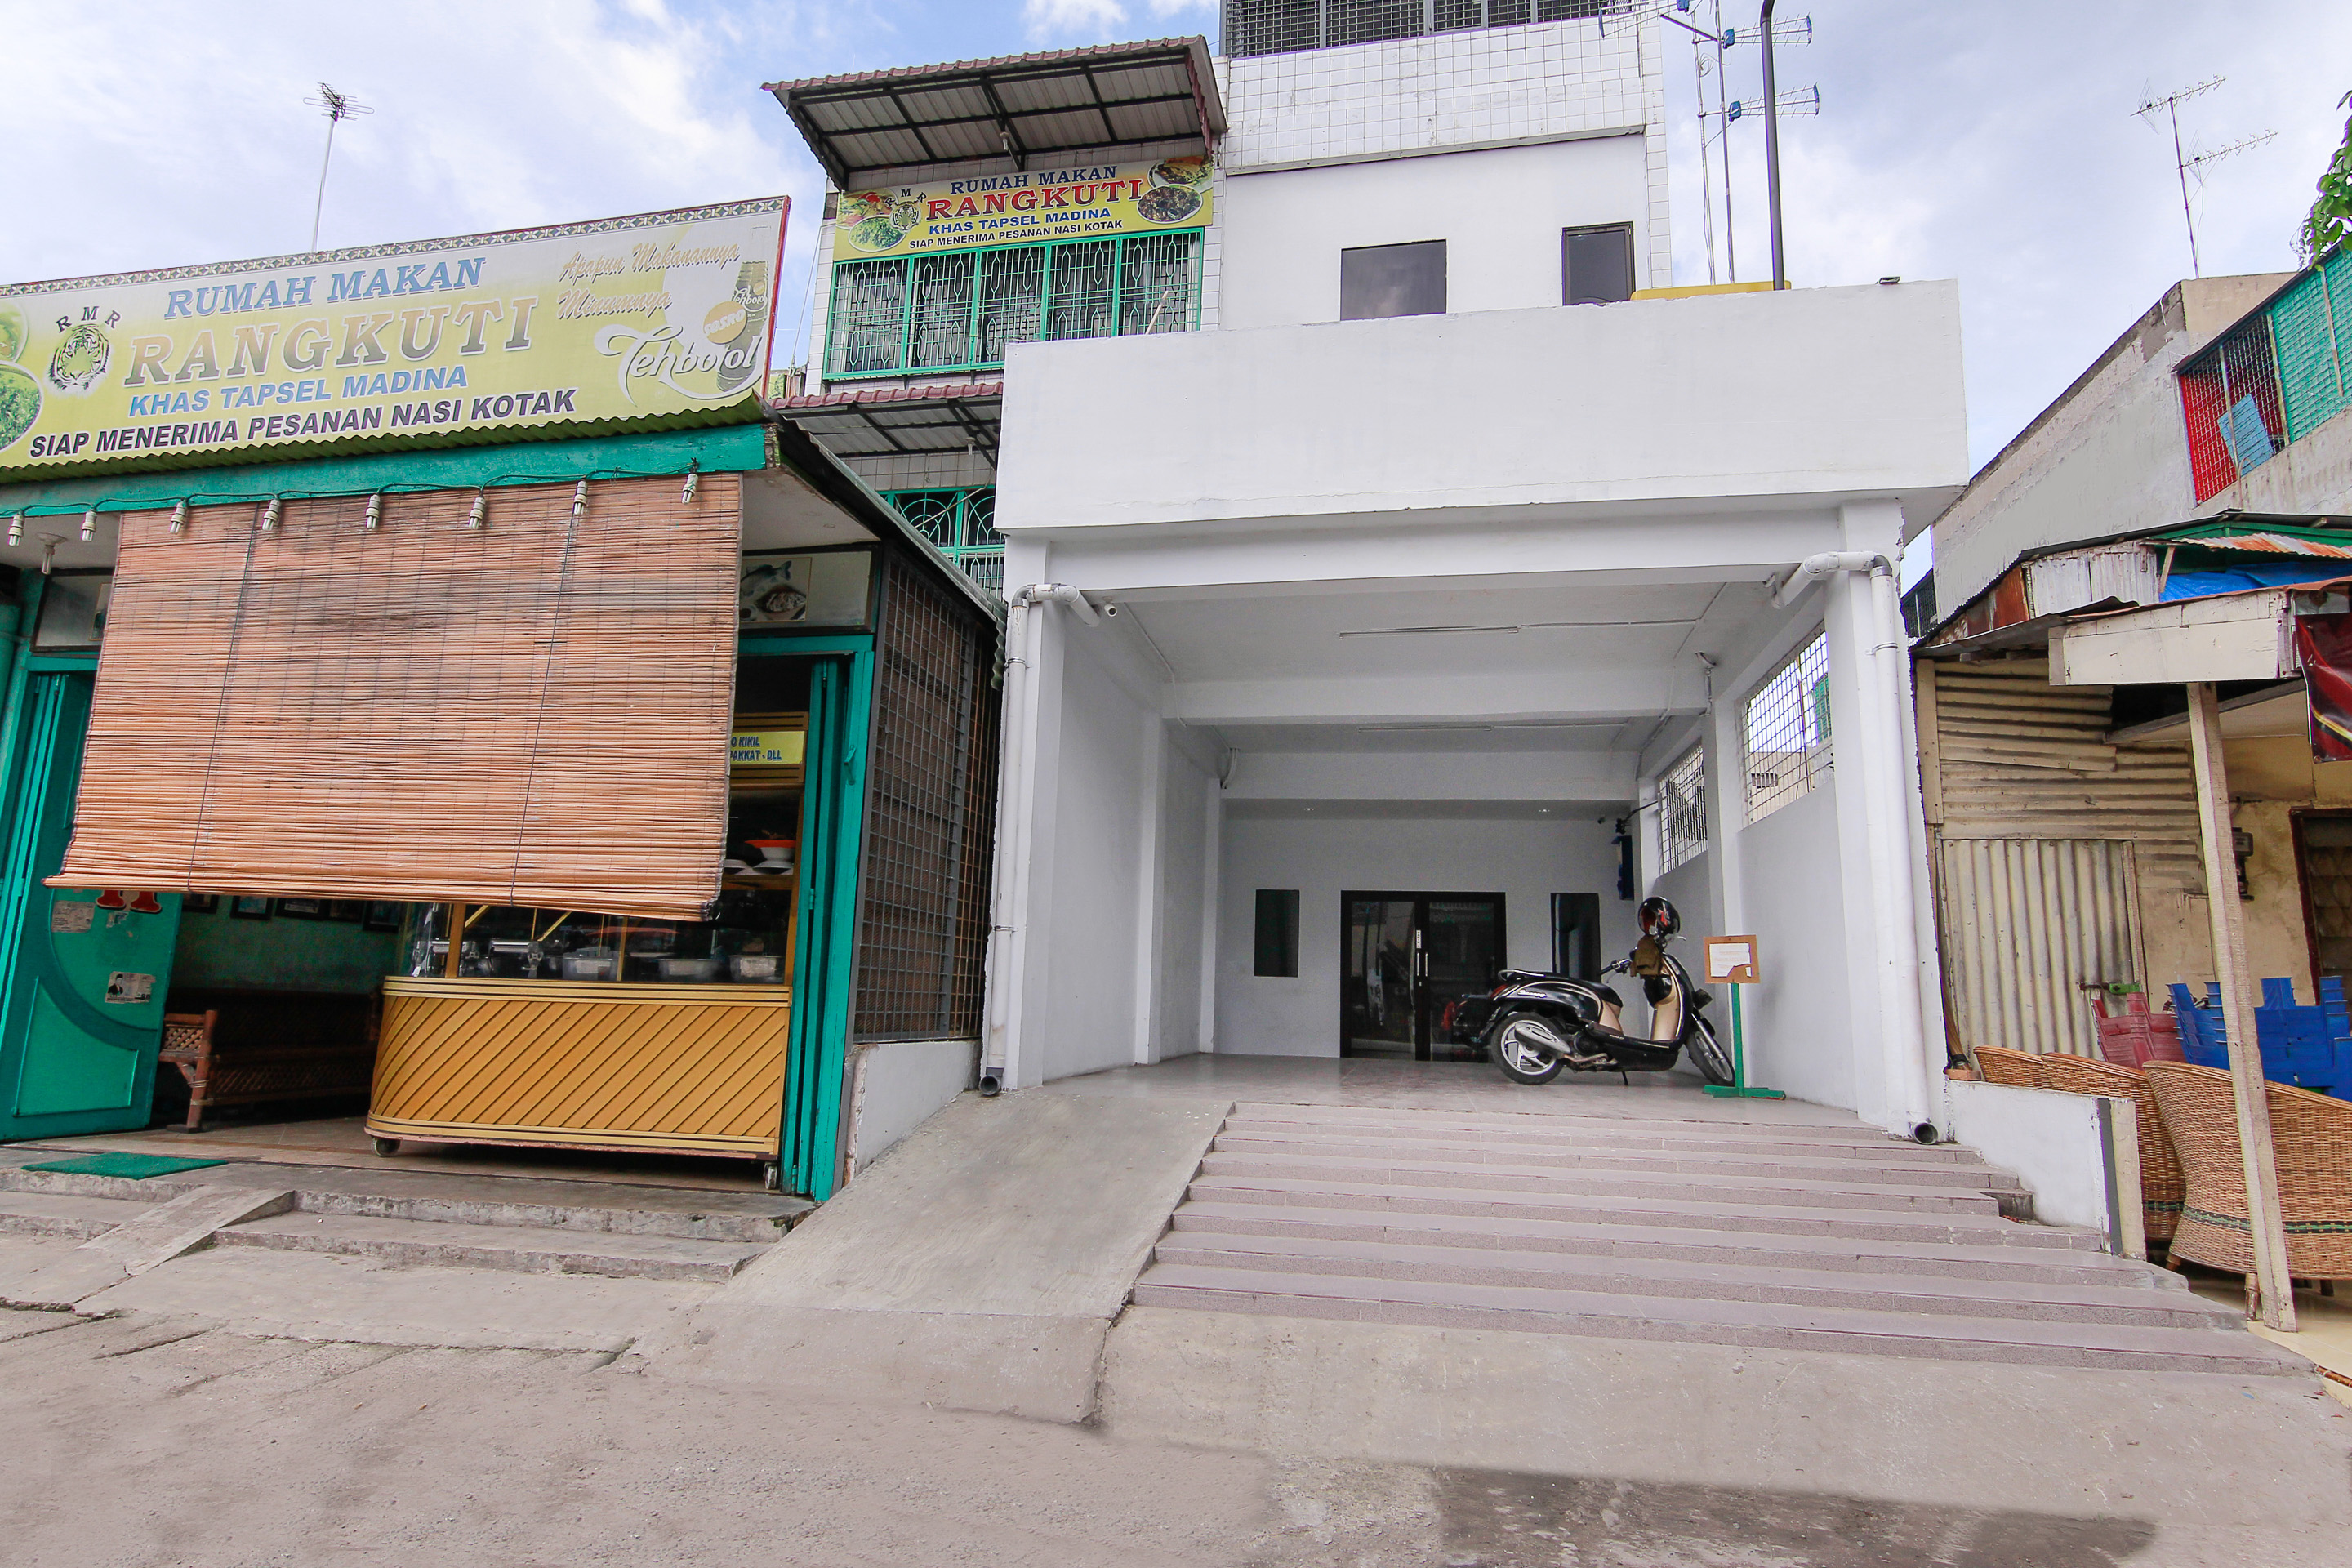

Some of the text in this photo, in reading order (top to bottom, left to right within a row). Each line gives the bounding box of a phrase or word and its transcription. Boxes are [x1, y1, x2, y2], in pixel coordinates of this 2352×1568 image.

[950, 166, 1117, 195] RUMAH MAKAN
[884, 188, 927, 207] R M R
[926, 179, 1143, 221] RANGKUTI
[909, 220, 1123, 249] SIAP MENERIMA PESANAN NASI KOTAK
[929, 207, 1111, 235] KHAS TAPSEL MADINA
[559, 242, 741, 286] Apapun Makanannya
[164, 257, 486, 319] RUMAH MAKAN
[557, 288, 673, 320] Minumnya
[55, 305, 122, 334] R M R
[123, 296, 538, 385] RANGKUTI
[594, 323, 764, 408] Tehbotol
[129, 366, 468, 417] KHAS TAPSEL MADINA
[29, 389, 577, 457] SIAP MENERIMA PESANAN NASI KOTAK
[738, 736, 760, 747] KIKIL
[767, 749, 782, 760] DLL
